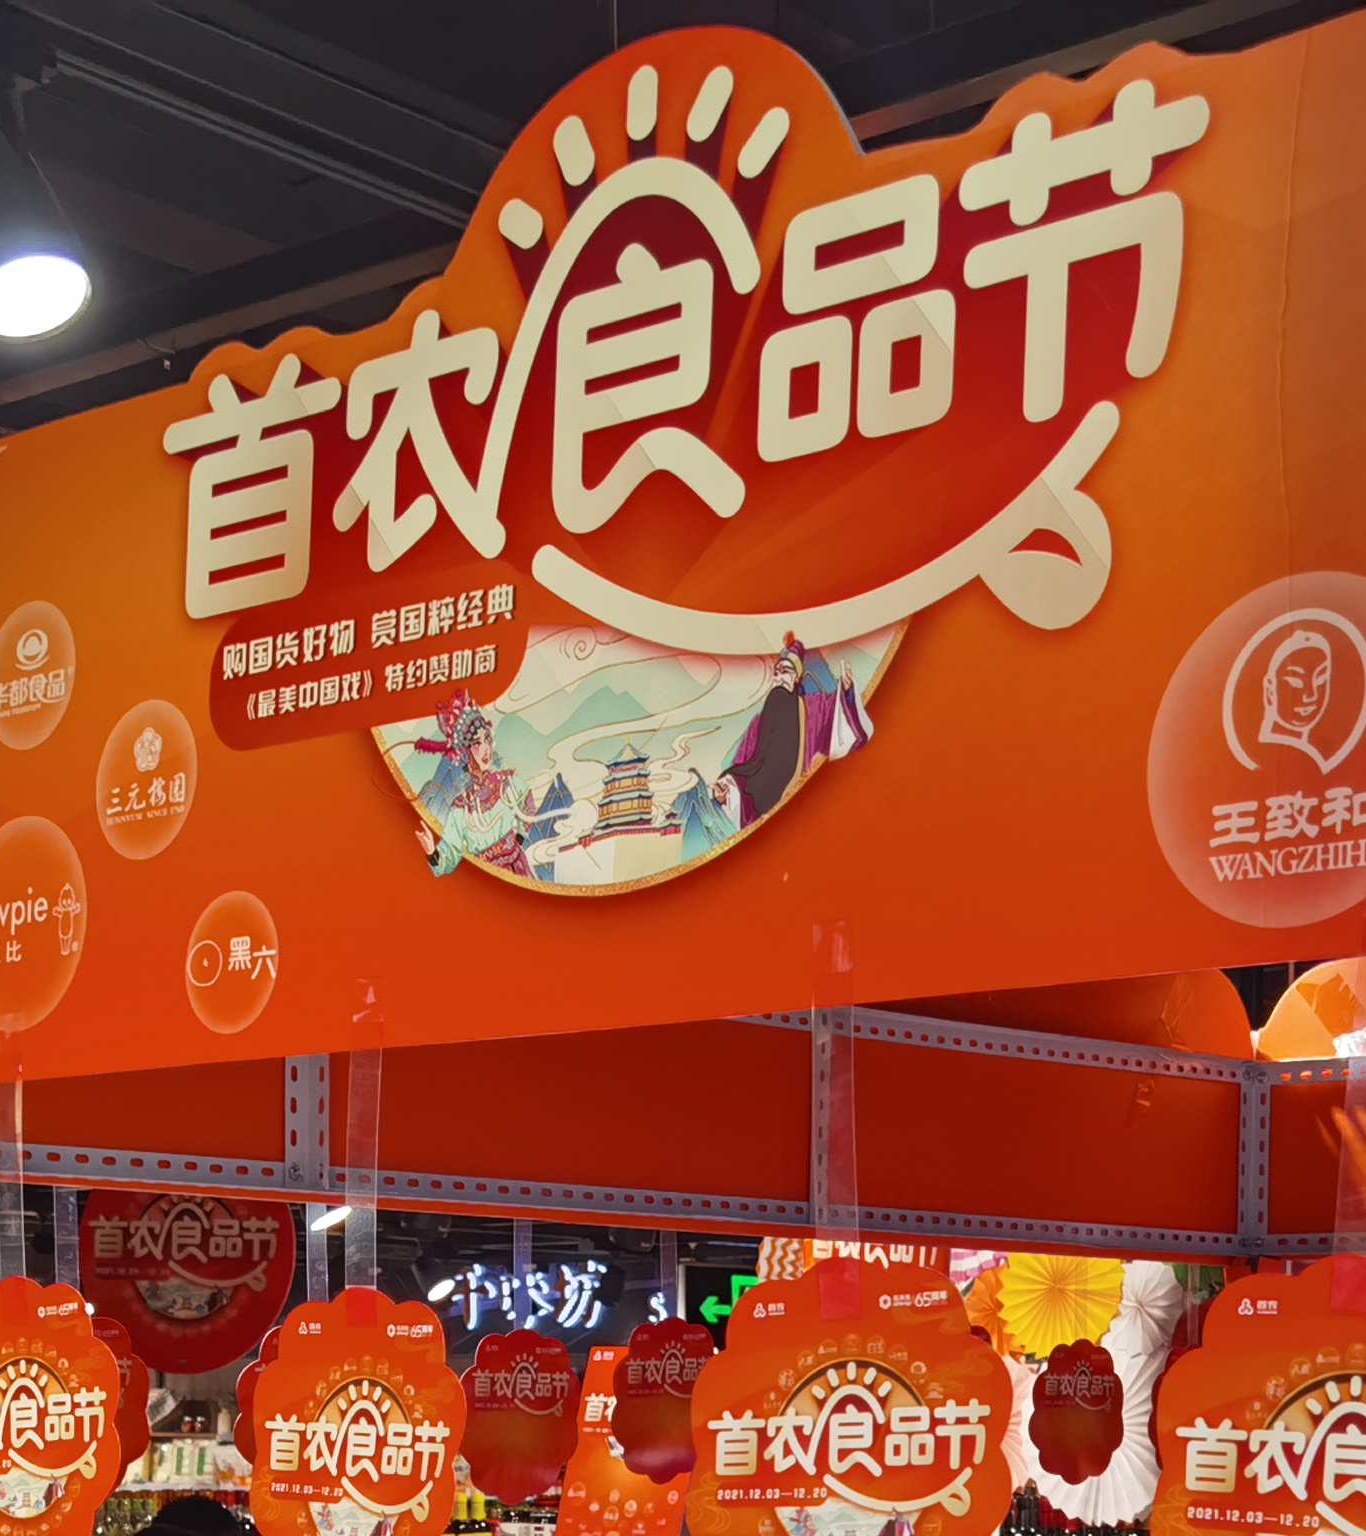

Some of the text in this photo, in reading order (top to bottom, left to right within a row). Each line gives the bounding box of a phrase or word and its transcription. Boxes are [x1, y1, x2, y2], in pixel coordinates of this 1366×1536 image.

[162, 79, 1209, 618] 首农食品节
[223, 584, 515, 677] 购国货好物 赏国粹经典
[384, 644, 498, 697] 特约赞助商
[228, 936, 277, 981] 黑六
[89, 1203, 280, 1264] 首农食品节
[472, 1363, 571, 1401] 首农食品节
[265, 1400, 450, 1481] 首农食品节
[707, 1386, 992, 1477] 首农食品节
